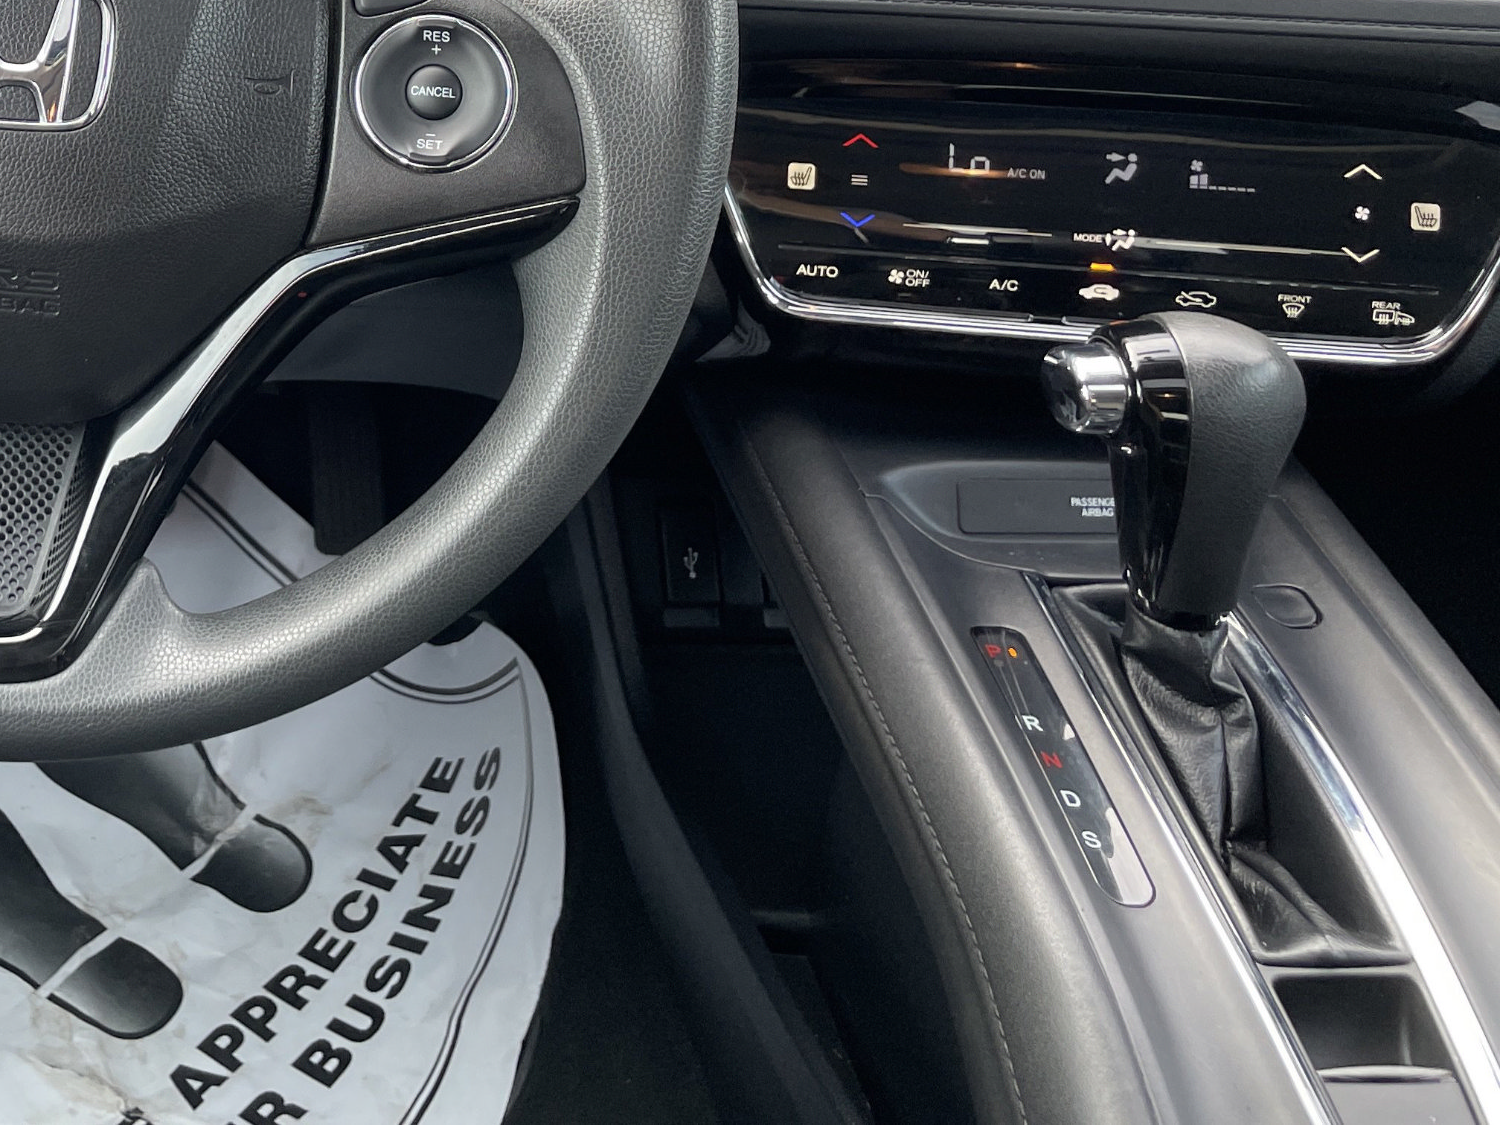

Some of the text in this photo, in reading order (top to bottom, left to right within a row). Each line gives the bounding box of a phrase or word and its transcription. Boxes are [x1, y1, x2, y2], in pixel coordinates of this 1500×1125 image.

[423, 30, 451, 43] RES
[410, 86, 457, 99] CANCEL
[416, 139, 443, 151] SET
[1007, 167, 1046, 179] A/C ON
[1073, 233, 1103, 243] MODE
[796, 264, 839, 279] AUTO
[905, 268, 930, 279] ON/
[904, 277, 931, 288] OFF
[988, 278, 1019, 292] A/C
[1277, 294, 1312, 304] FRONT
[1372, 301, 1401, 310] REAR
[984, 644, 1002, 658] P
[1022, 714, 1045, 732] R
[1040, 751, 1063, 768] N
[1060, 789, 1081, 808] D
[1081, 830, 1102, 849] S
[291, 746, 501, 1089] BUSINESS
[169, 756, 466, 1111] APPRECIATE
